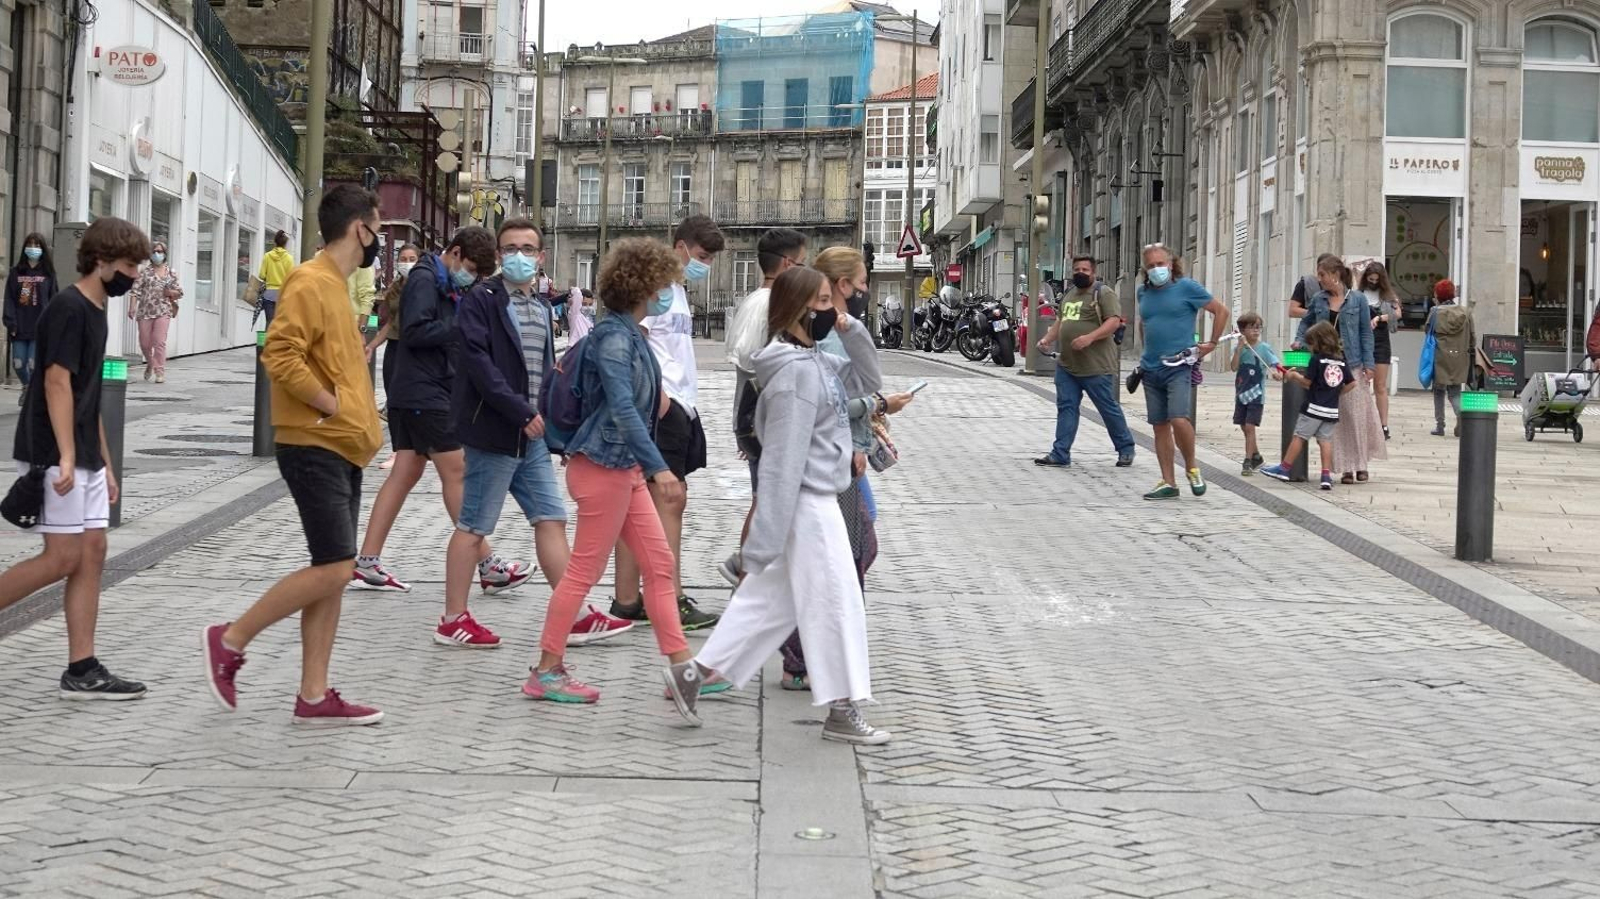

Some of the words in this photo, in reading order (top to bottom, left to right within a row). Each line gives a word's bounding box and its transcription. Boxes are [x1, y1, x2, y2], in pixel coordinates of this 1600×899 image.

[108, 51, 157, 67] PATO
[1403, 158, 1450, 169] PAPERO
[1536, 159, 1573, 169] panna
[1541, 167, 1583, 180] fragola
